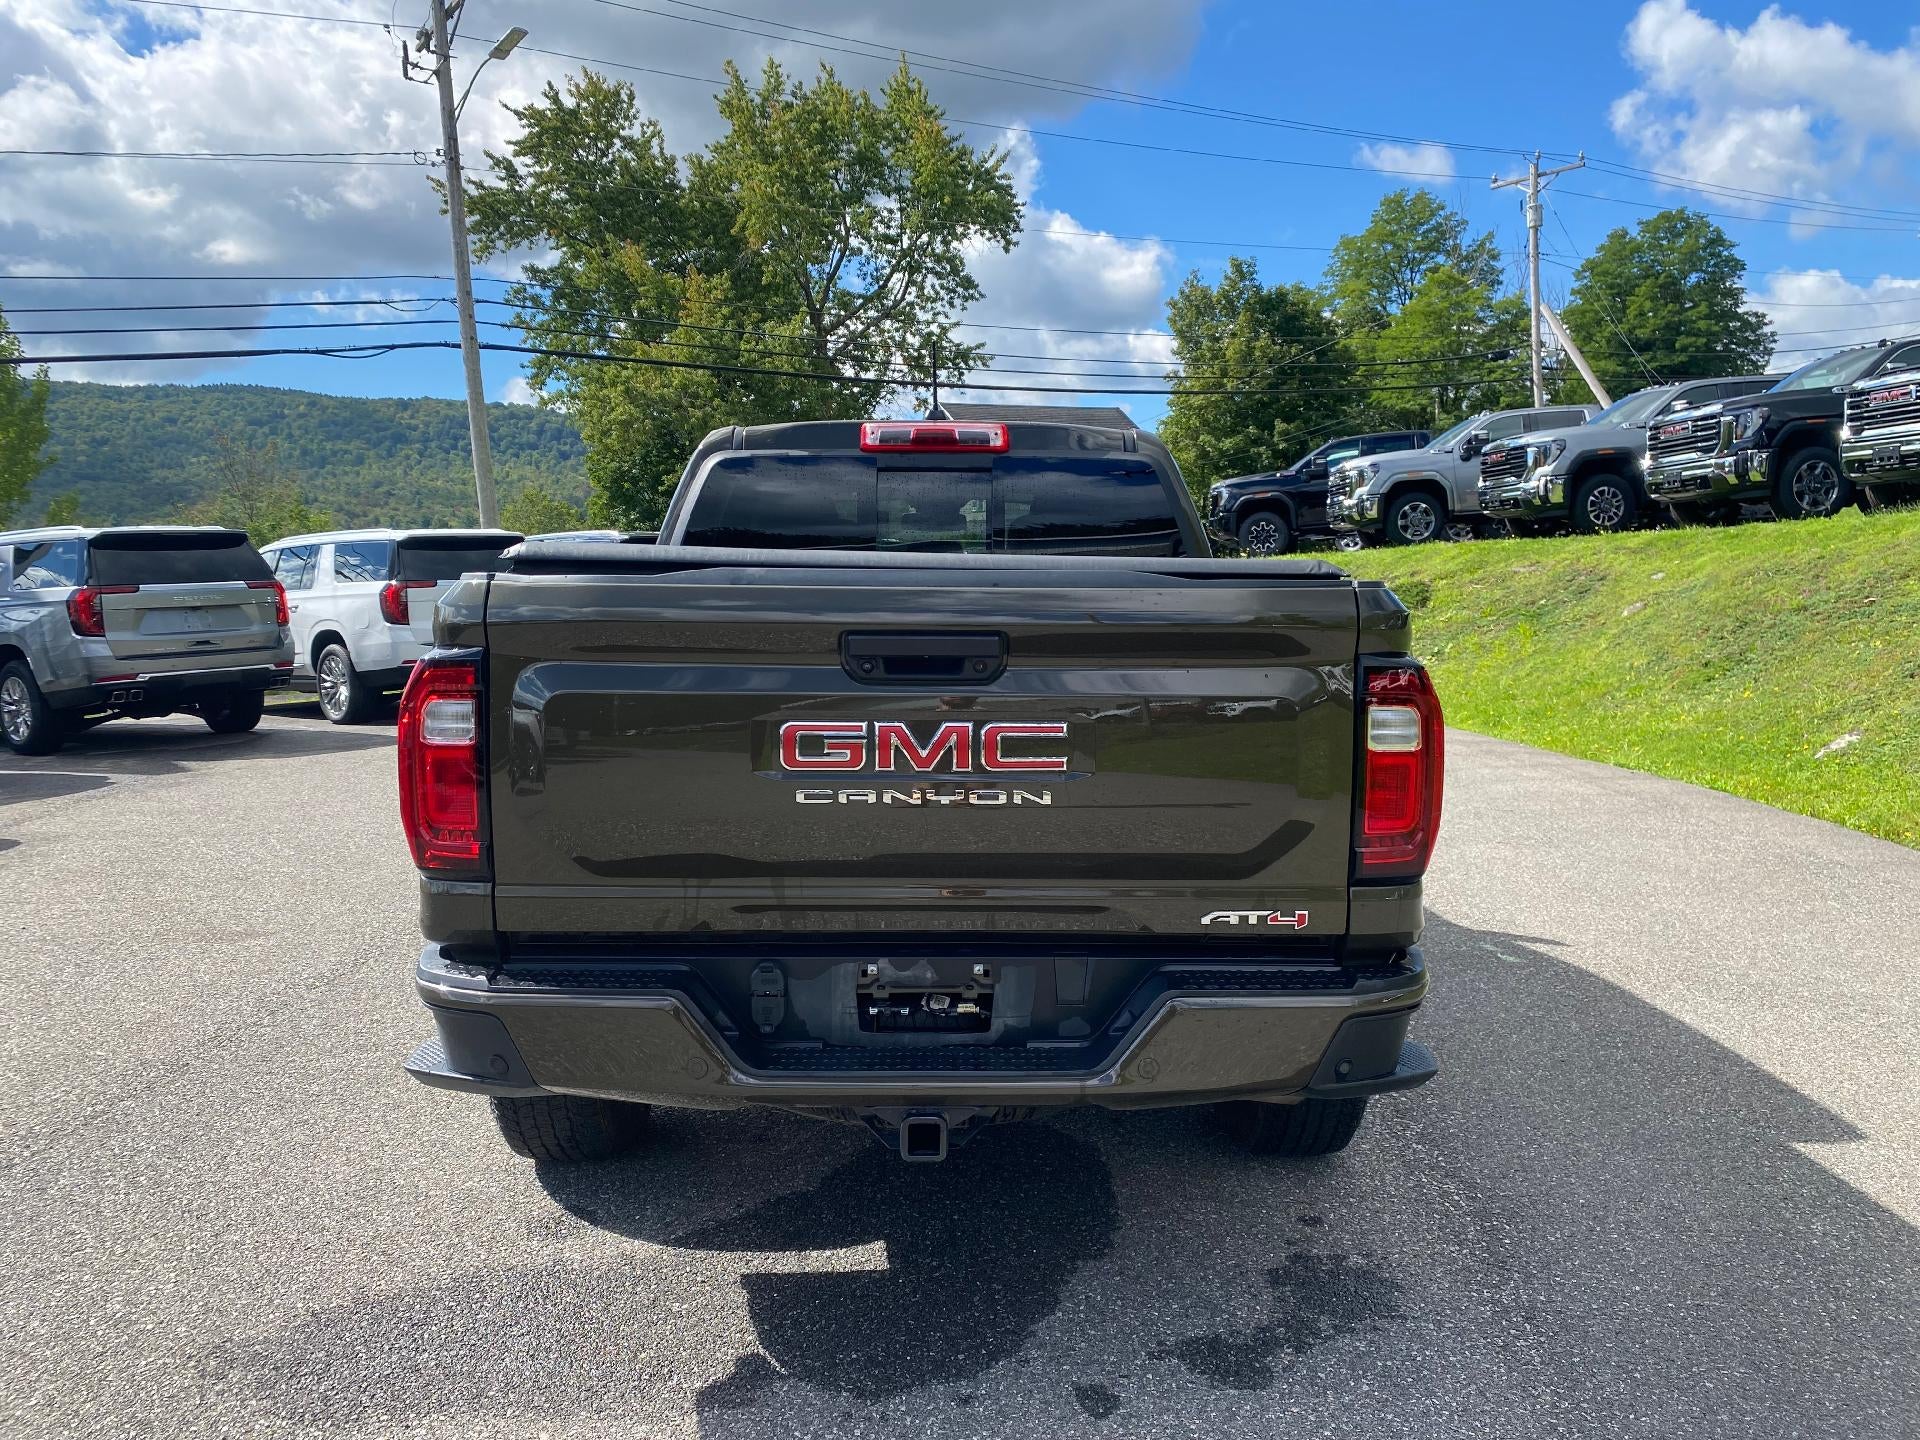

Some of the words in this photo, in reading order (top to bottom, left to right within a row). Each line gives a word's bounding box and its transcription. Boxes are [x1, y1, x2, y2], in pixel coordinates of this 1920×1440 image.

[1869, 387, 1911, 405] GMC
[779, 720, 1069, 772] GMC
[795, 789, 1052, 805] CANYON
[1200, 910, 1309, 930] AT4
